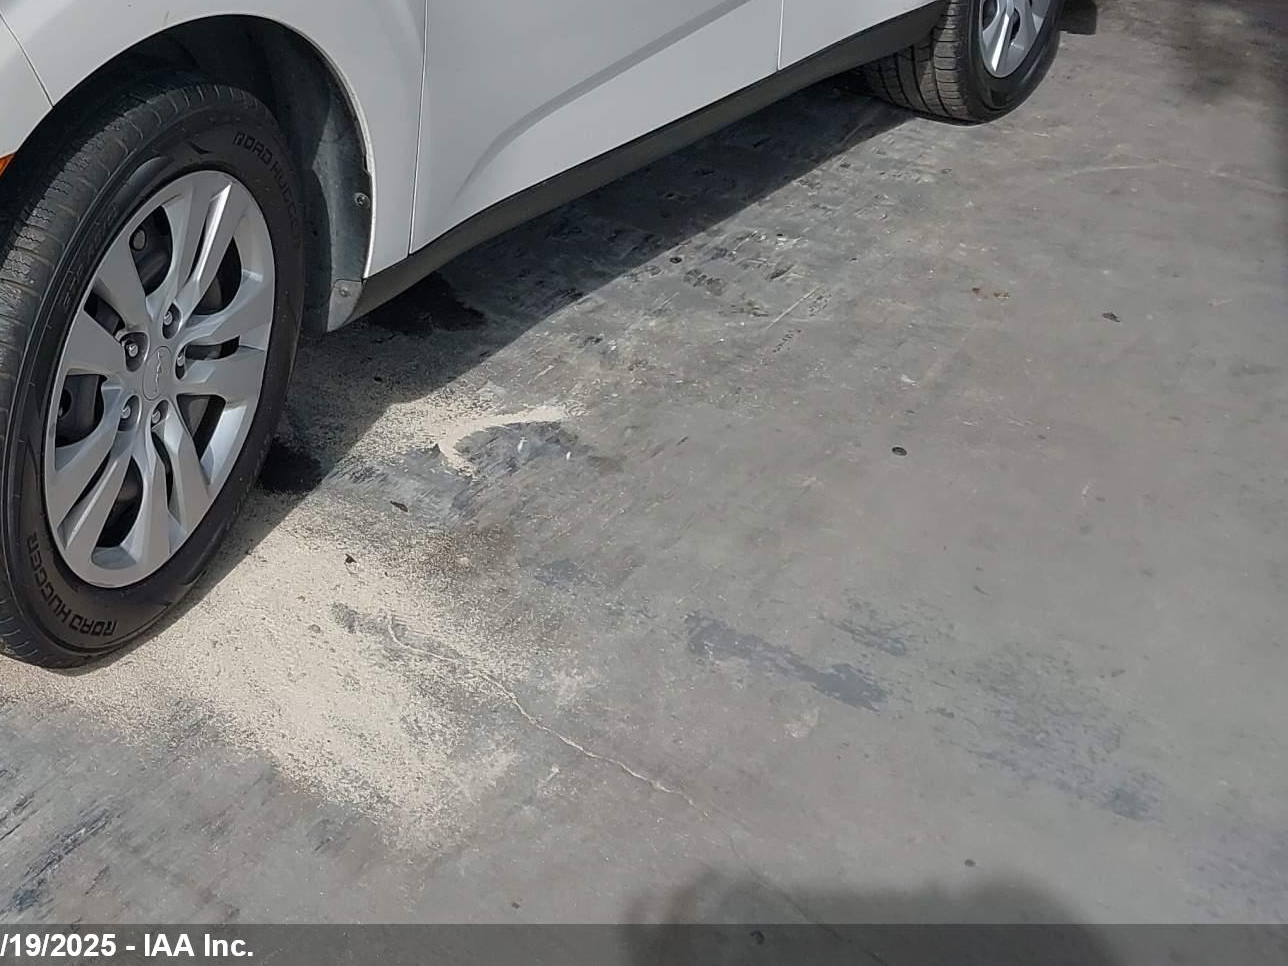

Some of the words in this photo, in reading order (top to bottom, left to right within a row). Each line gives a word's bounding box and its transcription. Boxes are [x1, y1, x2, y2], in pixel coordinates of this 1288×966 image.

[232, 131, 273, 165] ROAD
[27, 531, 72, 622] HUGGER
[69, 614, 117, 636] ROAD
